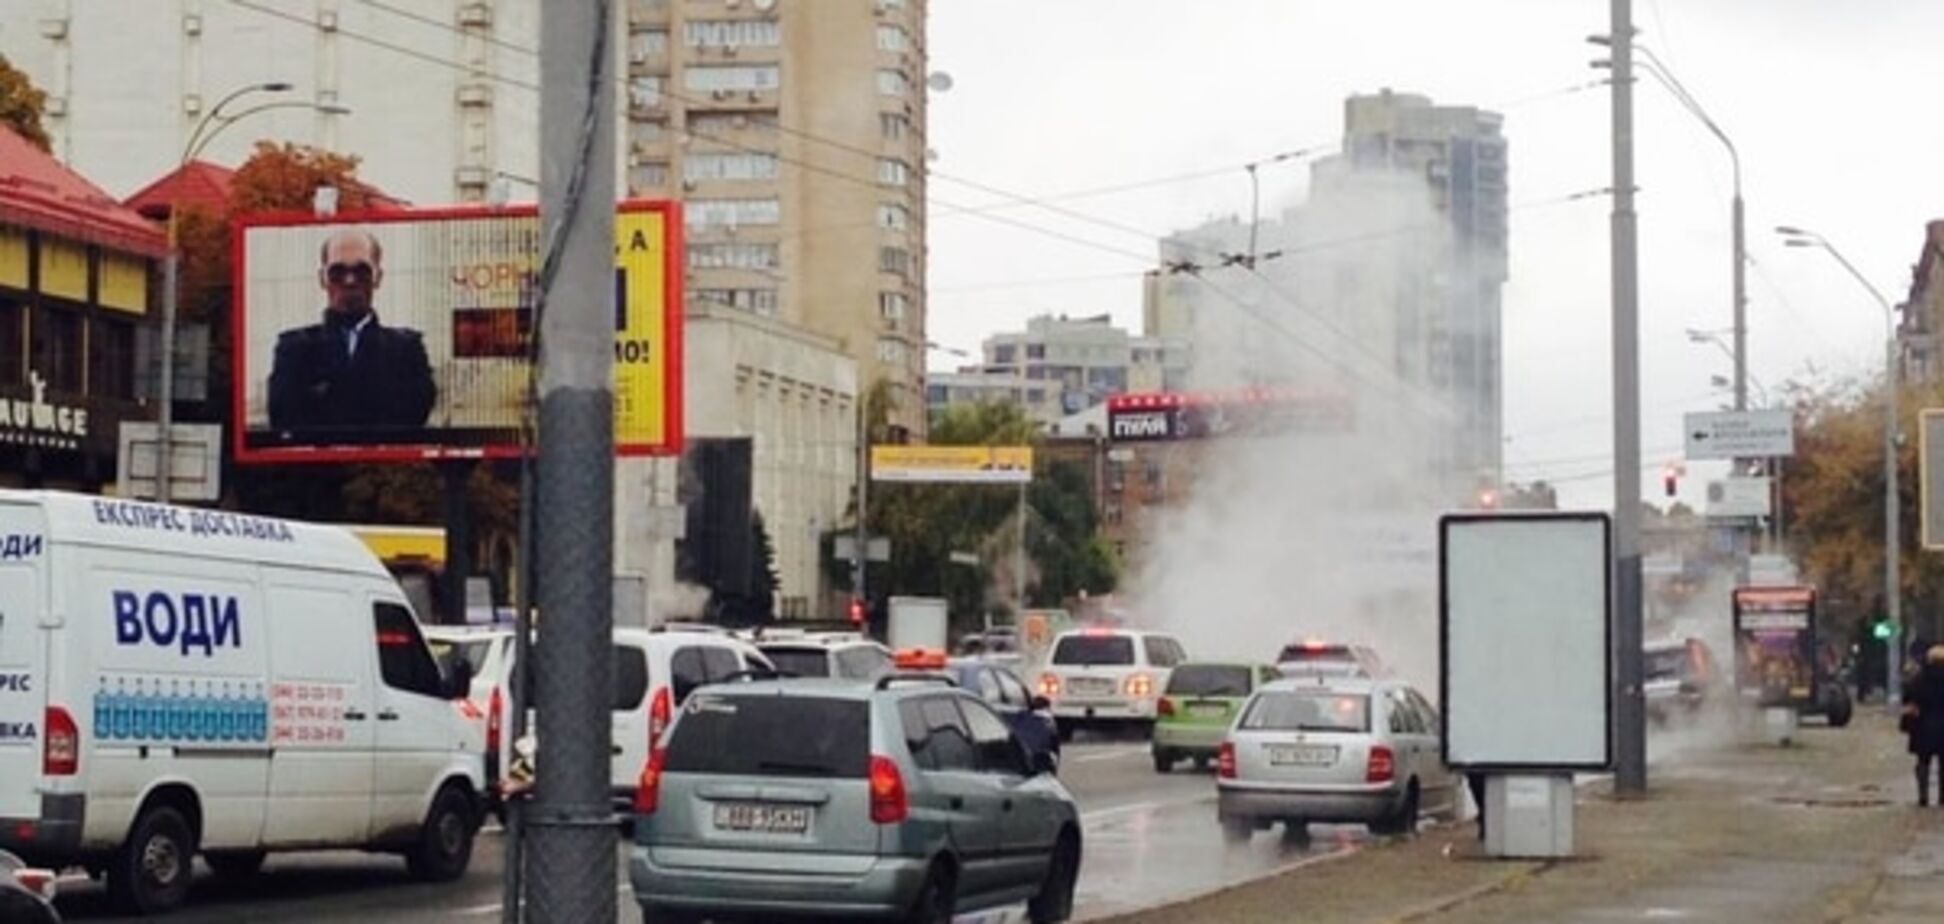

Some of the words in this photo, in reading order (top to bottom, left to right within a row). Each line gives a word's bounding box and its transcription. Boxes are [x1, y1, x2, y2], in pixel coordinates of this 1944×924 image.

[93, 499, 185, 531] ЕКСПРЕС
[189, 511, 294, 542] ДОСТАВКА
[0, 534, 42, 559] ДИ
[113, 590, 241, 656] ВОДИ
